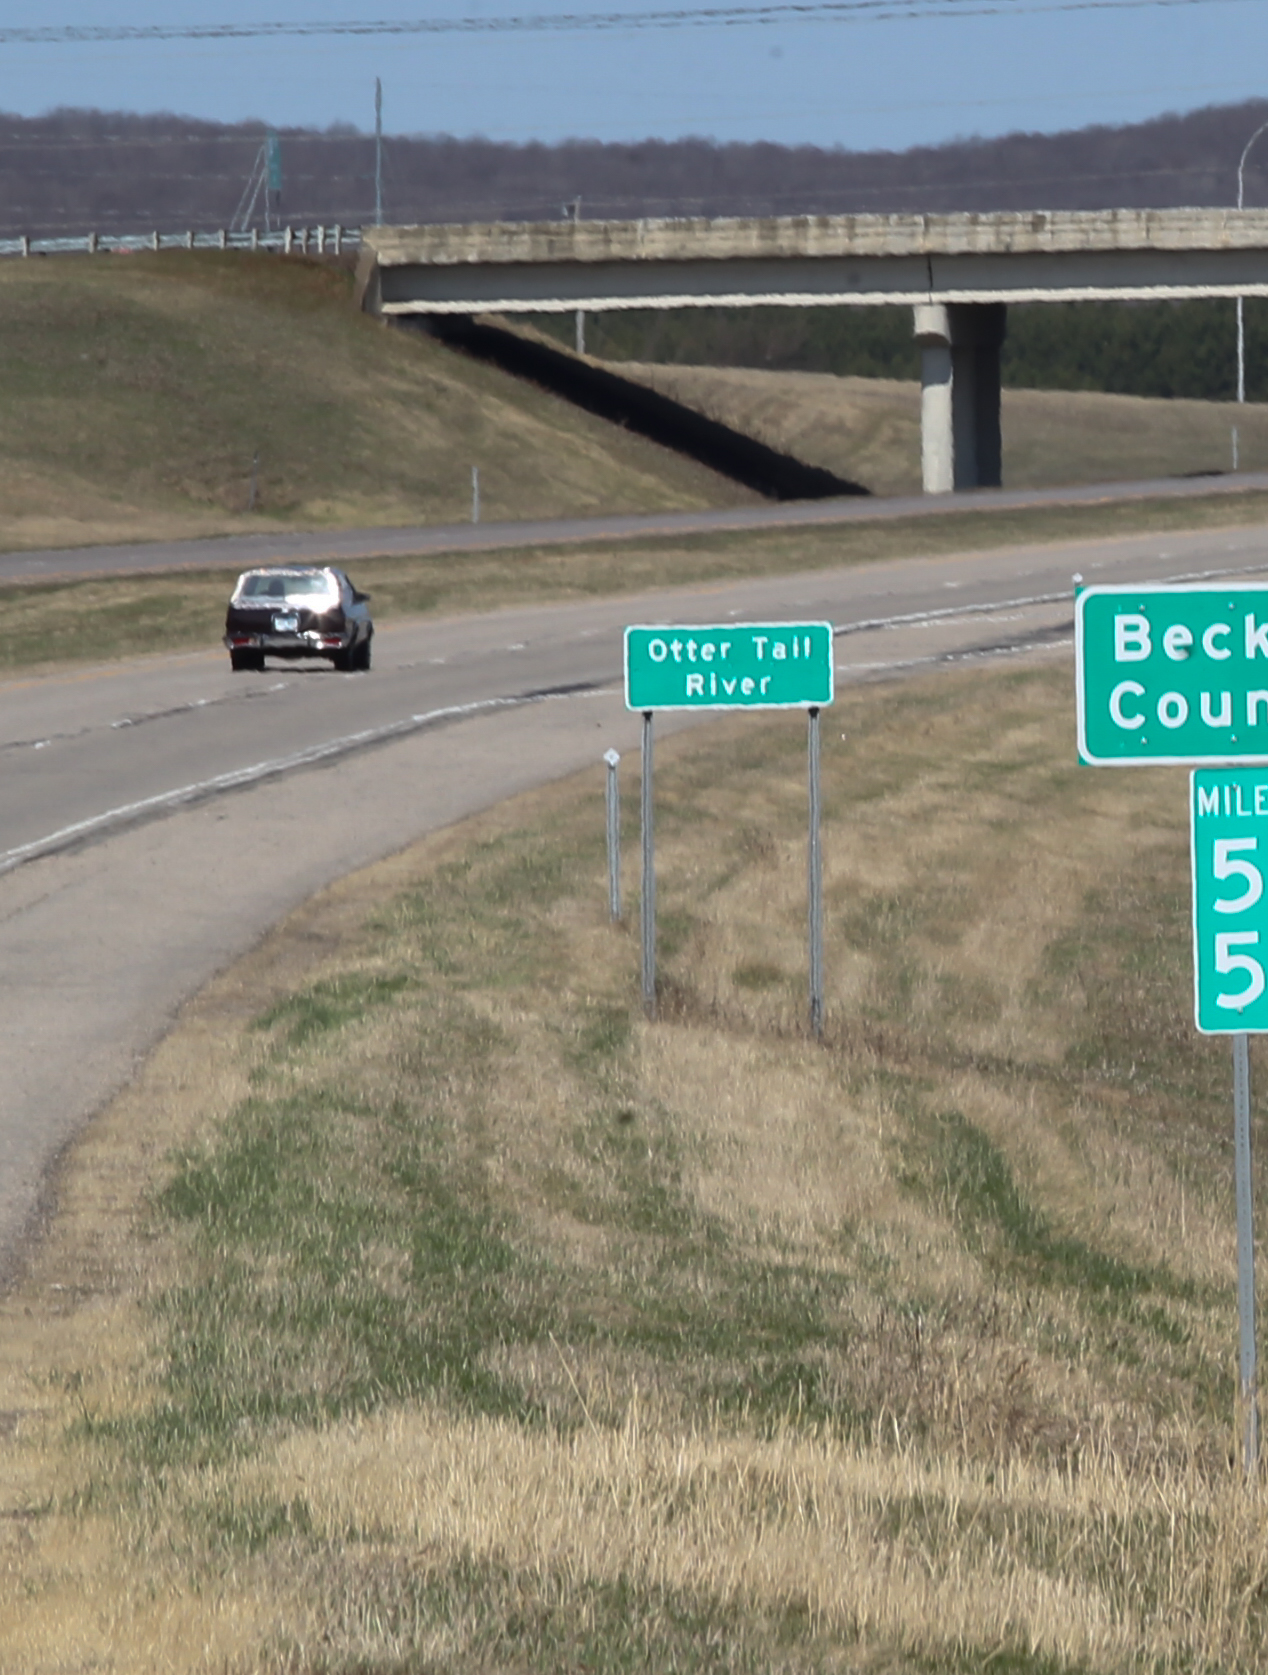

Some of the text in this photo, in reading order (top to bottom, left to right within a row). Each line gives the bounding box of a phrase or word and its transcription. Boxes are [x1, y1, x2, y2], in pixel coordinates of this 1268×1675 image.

[648, 635, 811, 663] Otter Tail
[685, 672, 772, 698] River
